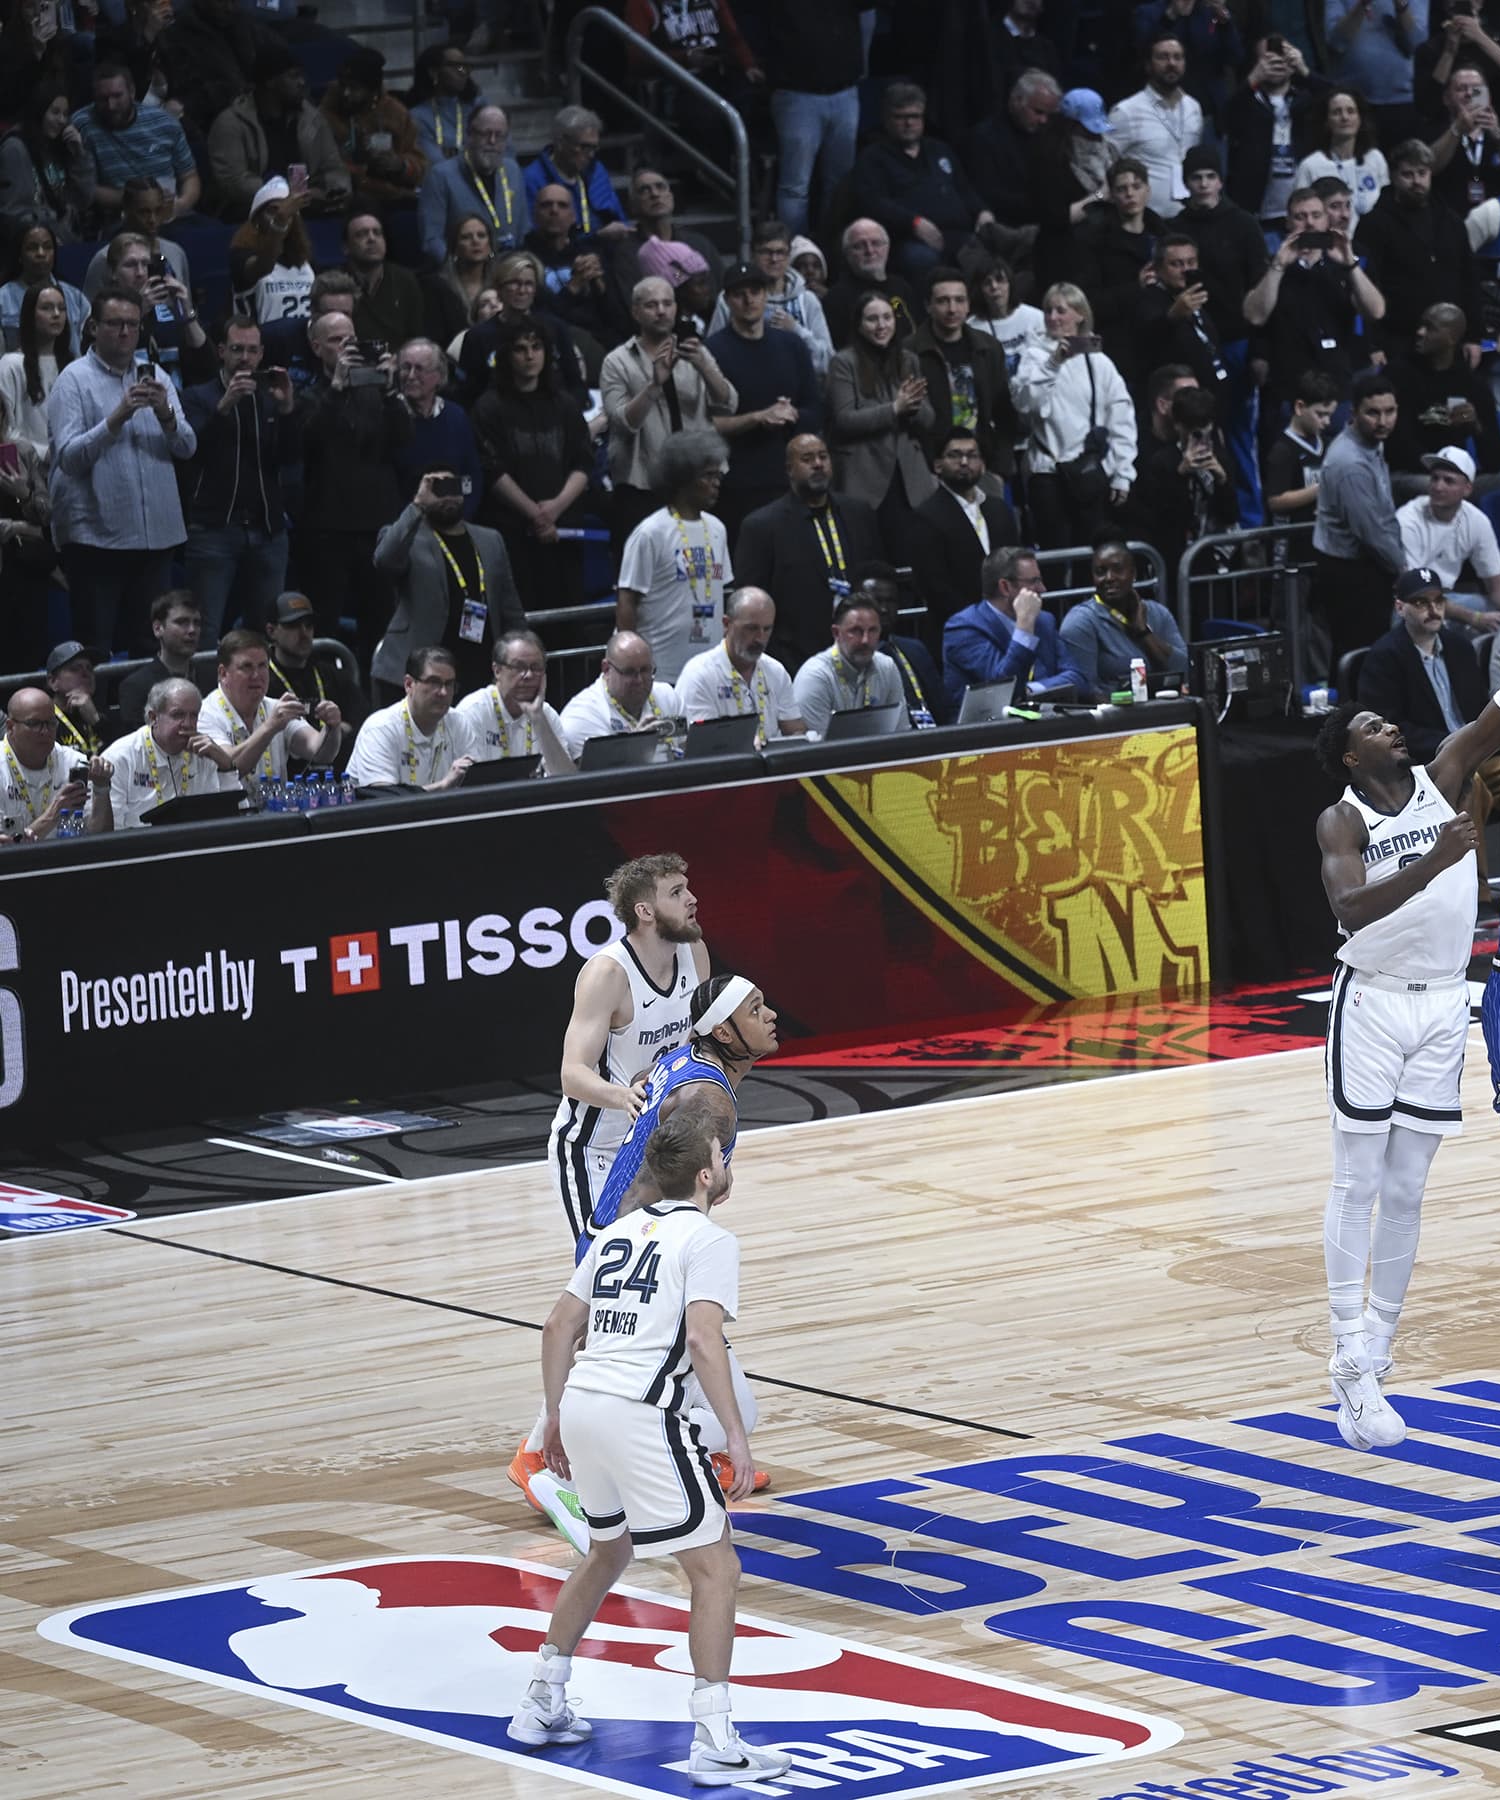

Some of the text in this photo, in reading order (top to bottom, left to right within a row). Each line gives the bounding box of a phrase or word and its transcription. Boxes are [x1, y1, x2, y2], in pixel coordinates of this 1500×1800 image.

[61, 900, 627, 1033] Presented by T TISSO
[638, 1016, 692, 1046] MEMPHI
[592, 1238, 662, 1304] 24
[593, 1309, 638, 1336] SPENCER
